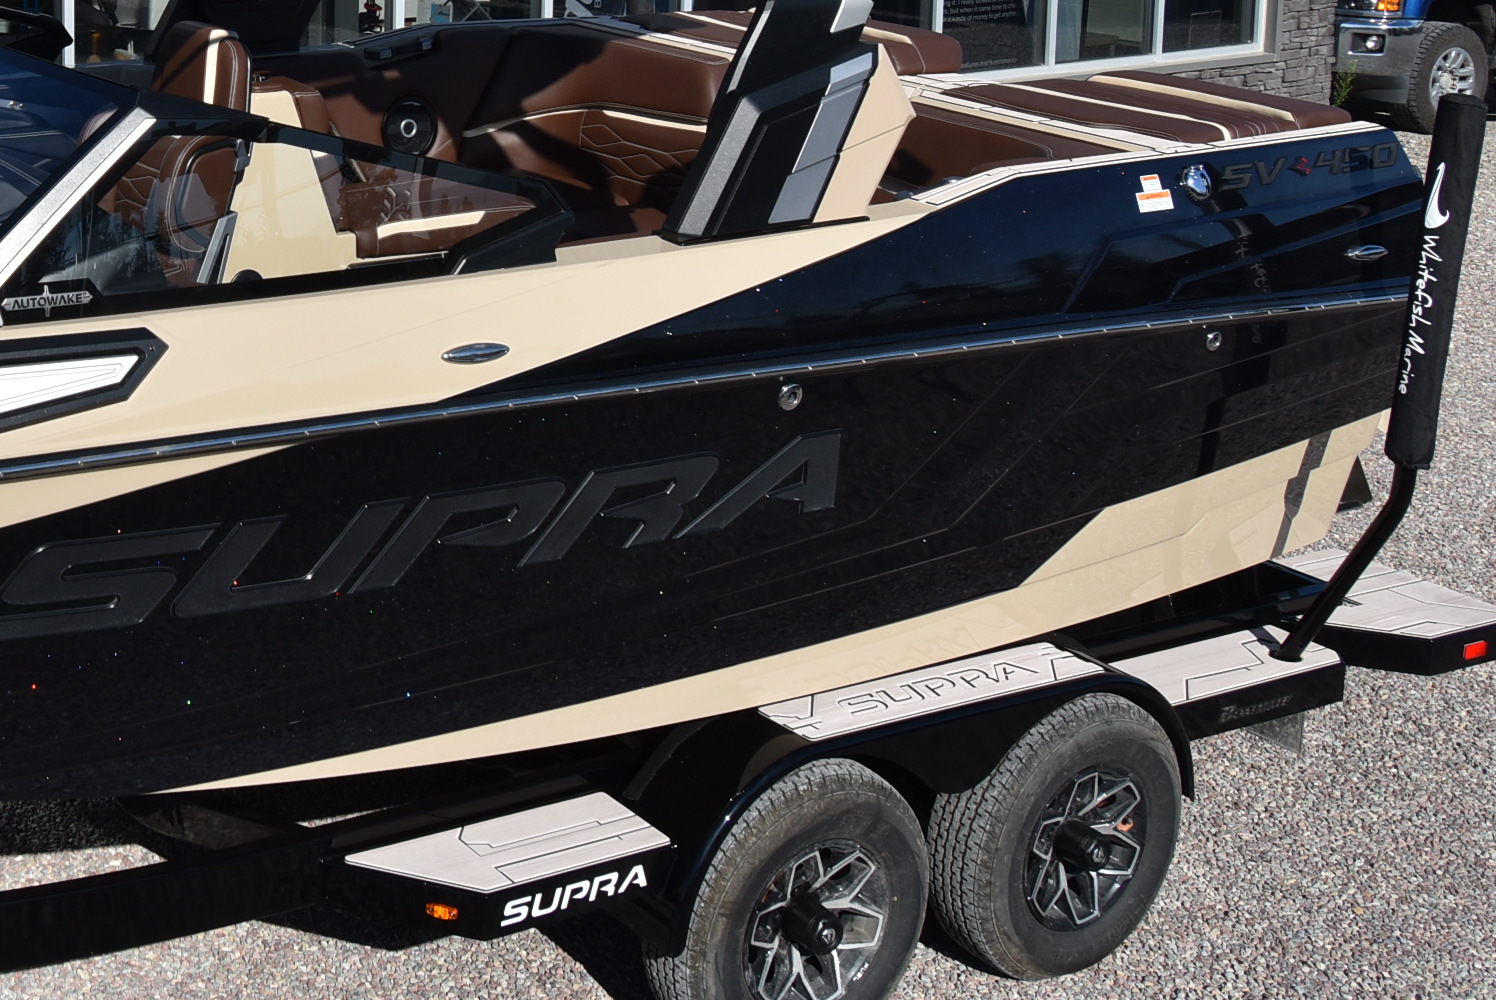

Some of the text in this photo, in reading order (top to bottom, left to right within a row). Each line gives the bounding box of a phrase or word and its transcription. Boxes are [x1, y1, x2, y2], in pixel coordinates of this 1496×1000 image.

[1220, 141, 1400, 192] SV 450
[11, 292, 83, 309] AUTOWAKE
[1399, 235, 1443, 394] Whitefish Marine
[837, 662, 1040, 717] SUPRA
[500, 864, 648, 927] SUPRA
